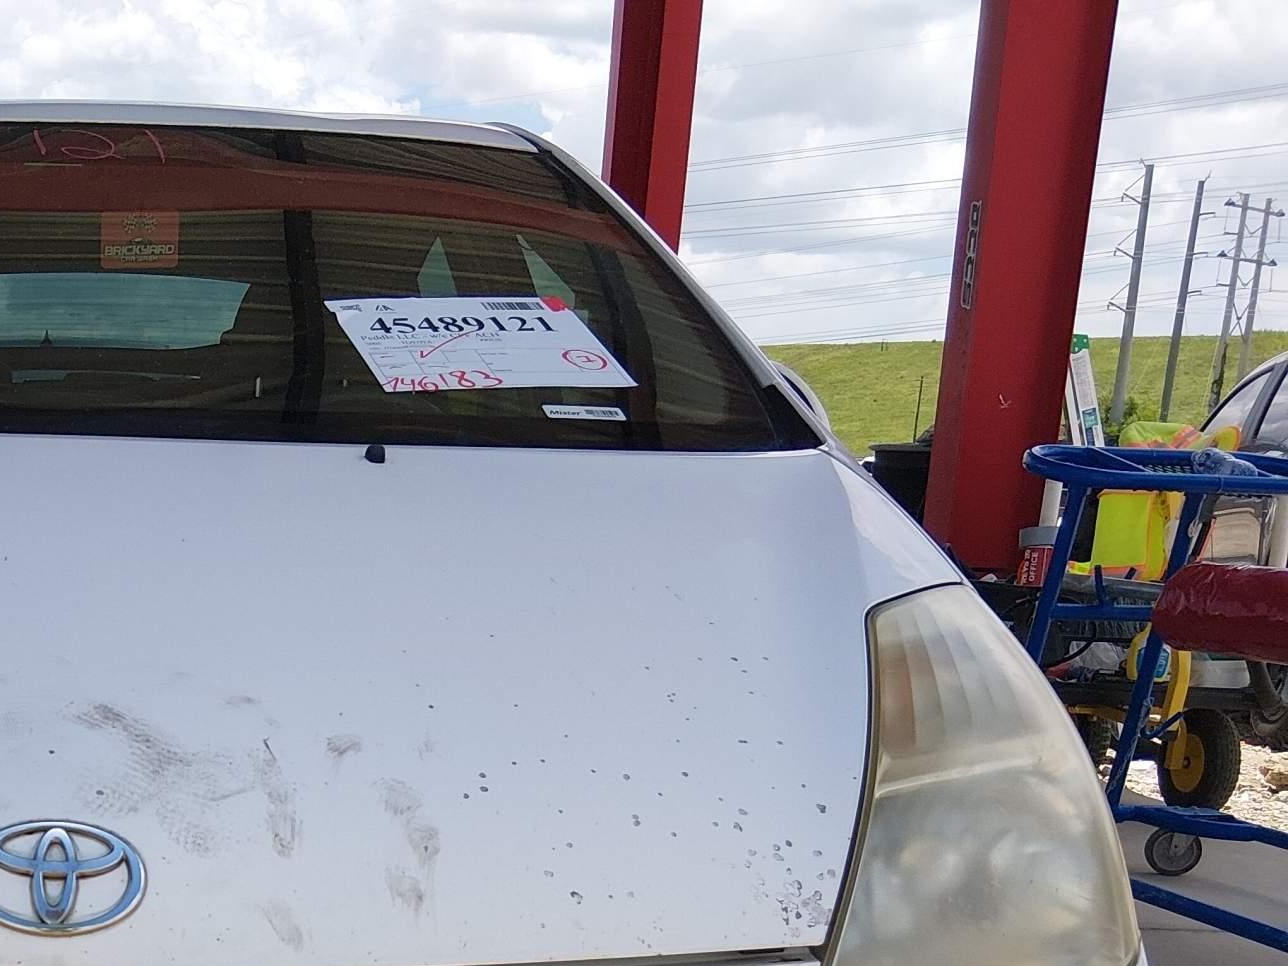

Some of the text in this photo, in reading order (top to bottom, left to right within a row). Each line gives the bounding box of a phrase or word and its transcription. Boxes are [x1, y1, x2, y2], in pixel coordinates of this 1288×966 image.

[104, 244, 175, 256] BRICKYARD
[370, 317, 557, 334] 45489121
[1029, 552, 1039, 582] OFFICE
